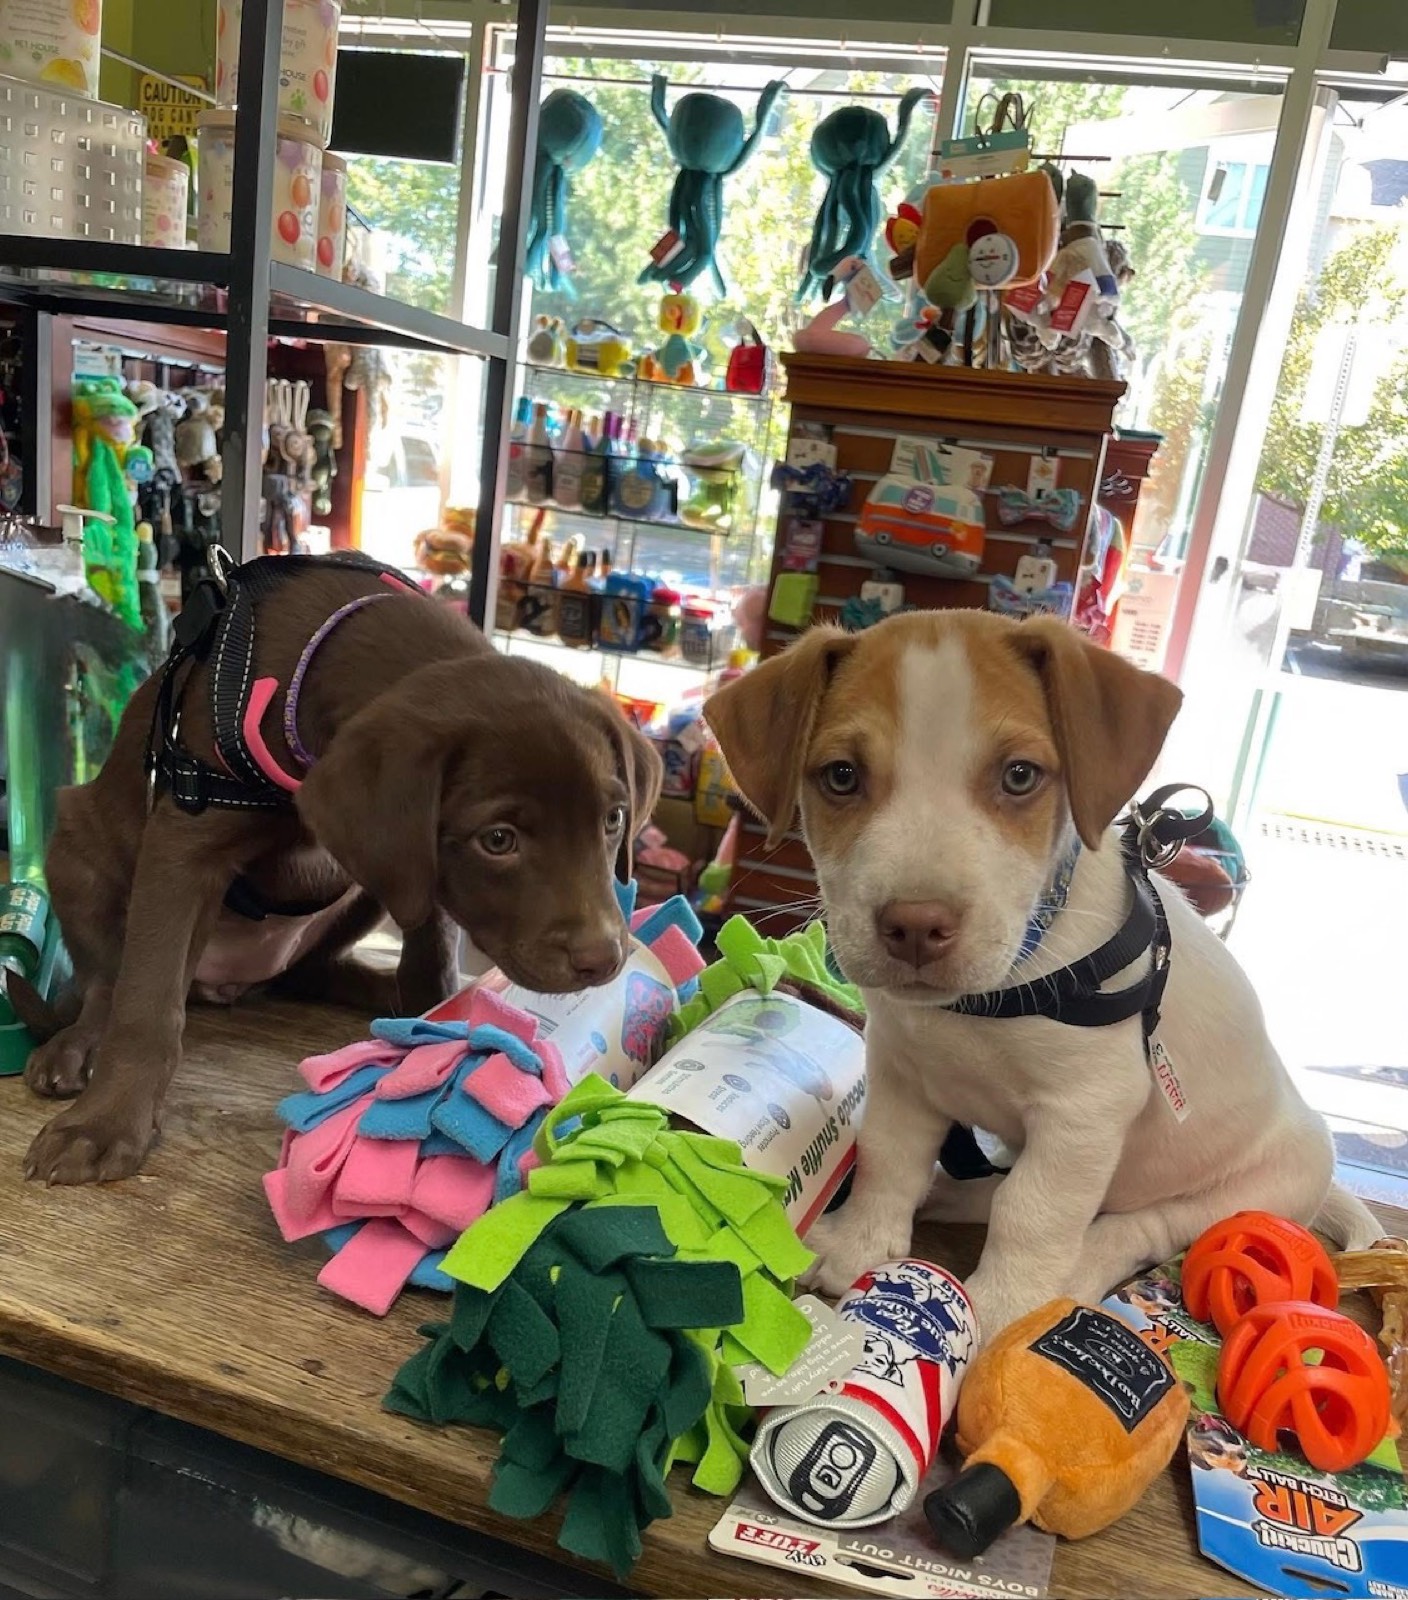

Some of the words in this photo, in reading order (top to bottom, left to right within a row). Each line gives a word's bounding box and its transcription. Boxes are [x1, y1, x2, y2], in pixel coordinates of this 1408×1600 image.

[838, 1079, 866, 1126] ocado
[800, 1116, 840, 1176] Snuffle
[830, 1333, 854, 1351] have
[806, 1353, 825, 1368] big
[808, 1364, 829, 1381] Tiny
[760, 1384, 776, 1400] we
[1259, 1467, 1298, 1492] BALL
[1302, 1480, 1346, 1507] FETCH
[1254, 1482, 1362, 1537] AIR
[740, 1526, 812, 1553] TUFF
[846, 1540, 896, 1561] OUT
[1258, 1520, 1361, 1572] Chuckit!
[898, 1555, 973, 1580] NIGHT
[978, 1572, 1039, 1597] BOYS
